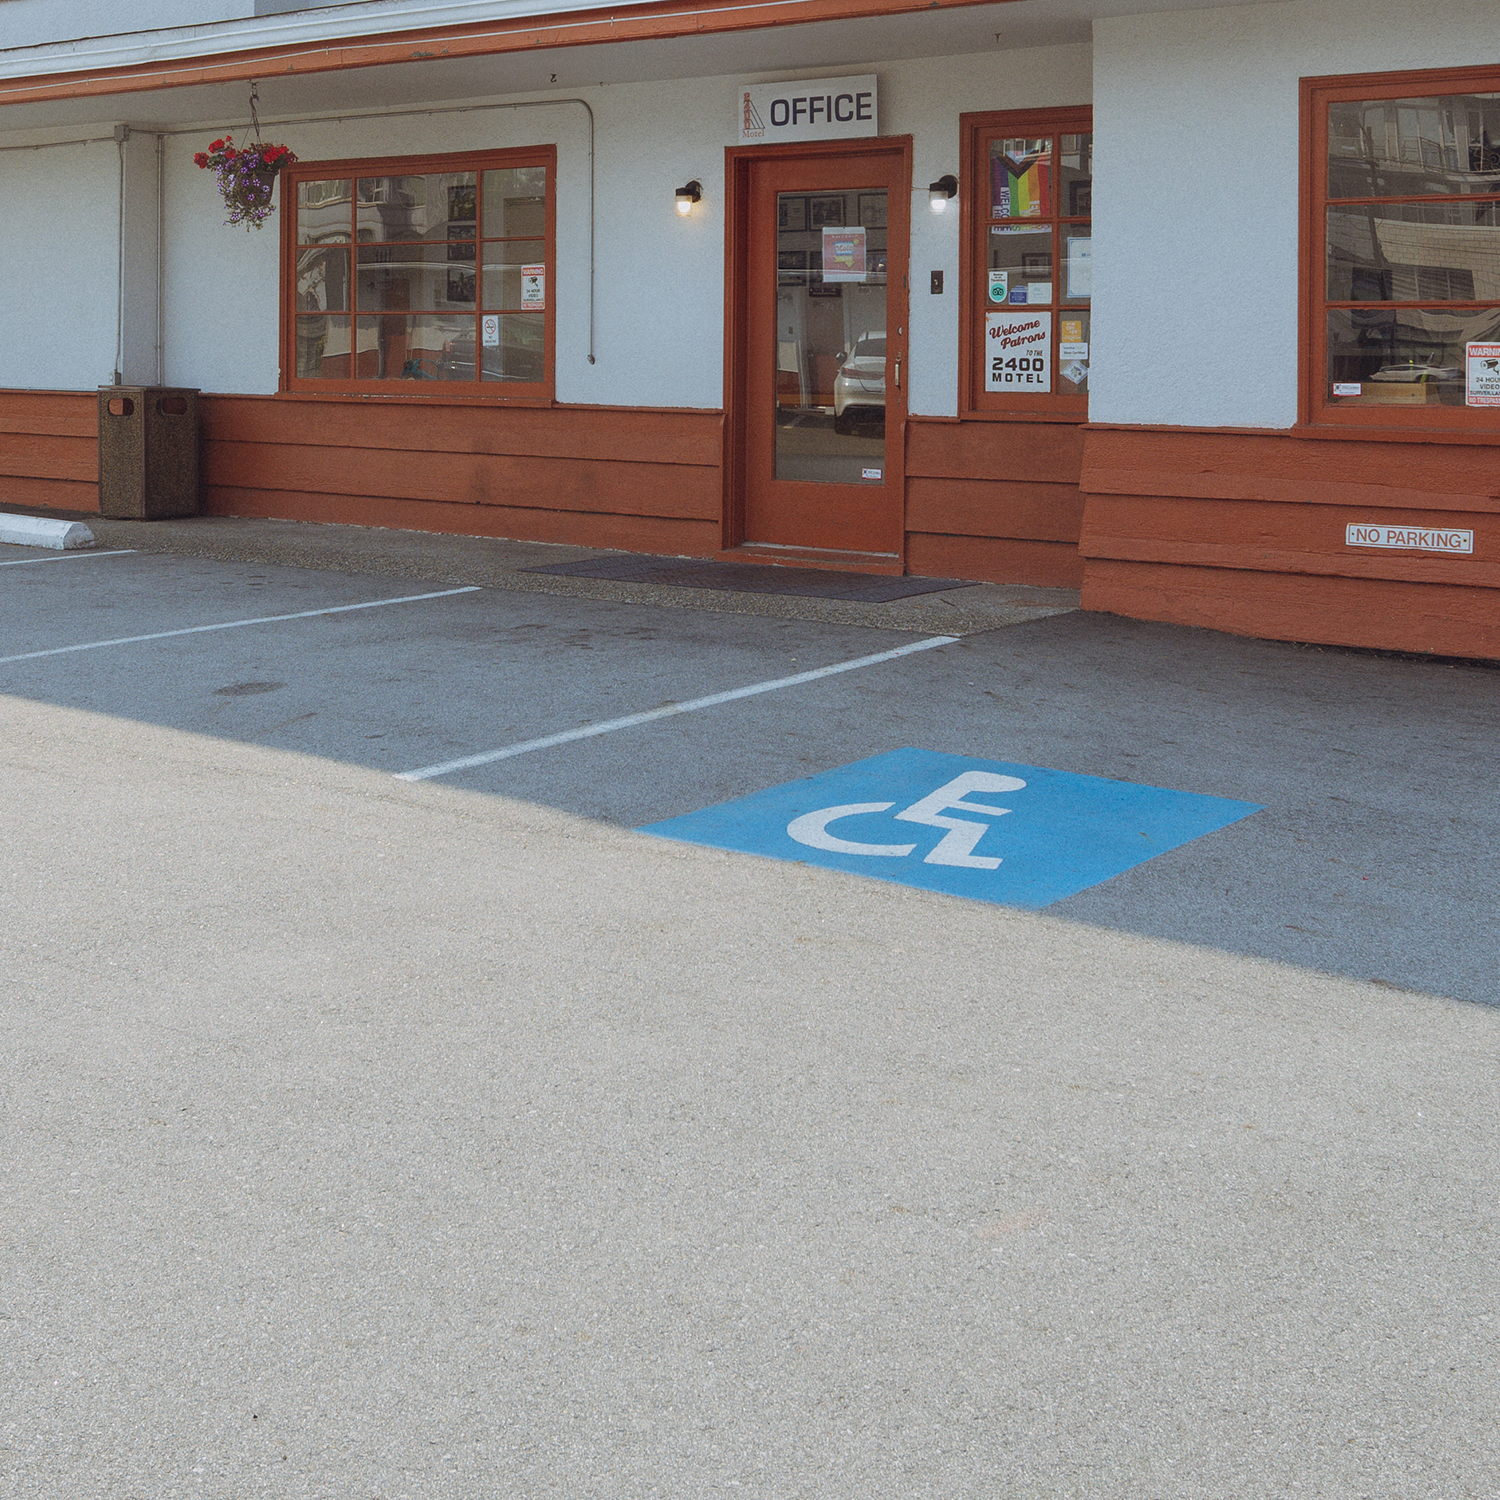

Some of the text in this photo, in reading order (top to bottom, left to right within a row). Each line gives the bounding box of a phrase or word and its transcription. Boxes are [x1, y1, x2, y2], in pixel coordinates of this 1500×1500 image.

[770, 92, 873, 127] OFFICE
[742, 128, 765, 138] Motel
[1001, 190, 1012, 231] WELCOE
[989, 320, 1041, 339] Welcome
[1000, 331, 1046, 350] Patrons
[992, 357, 1044, 372] 2400
[992, 372, 1044, 384] MOTEL
[1356, 528, 1462, 548] NO PARKING
